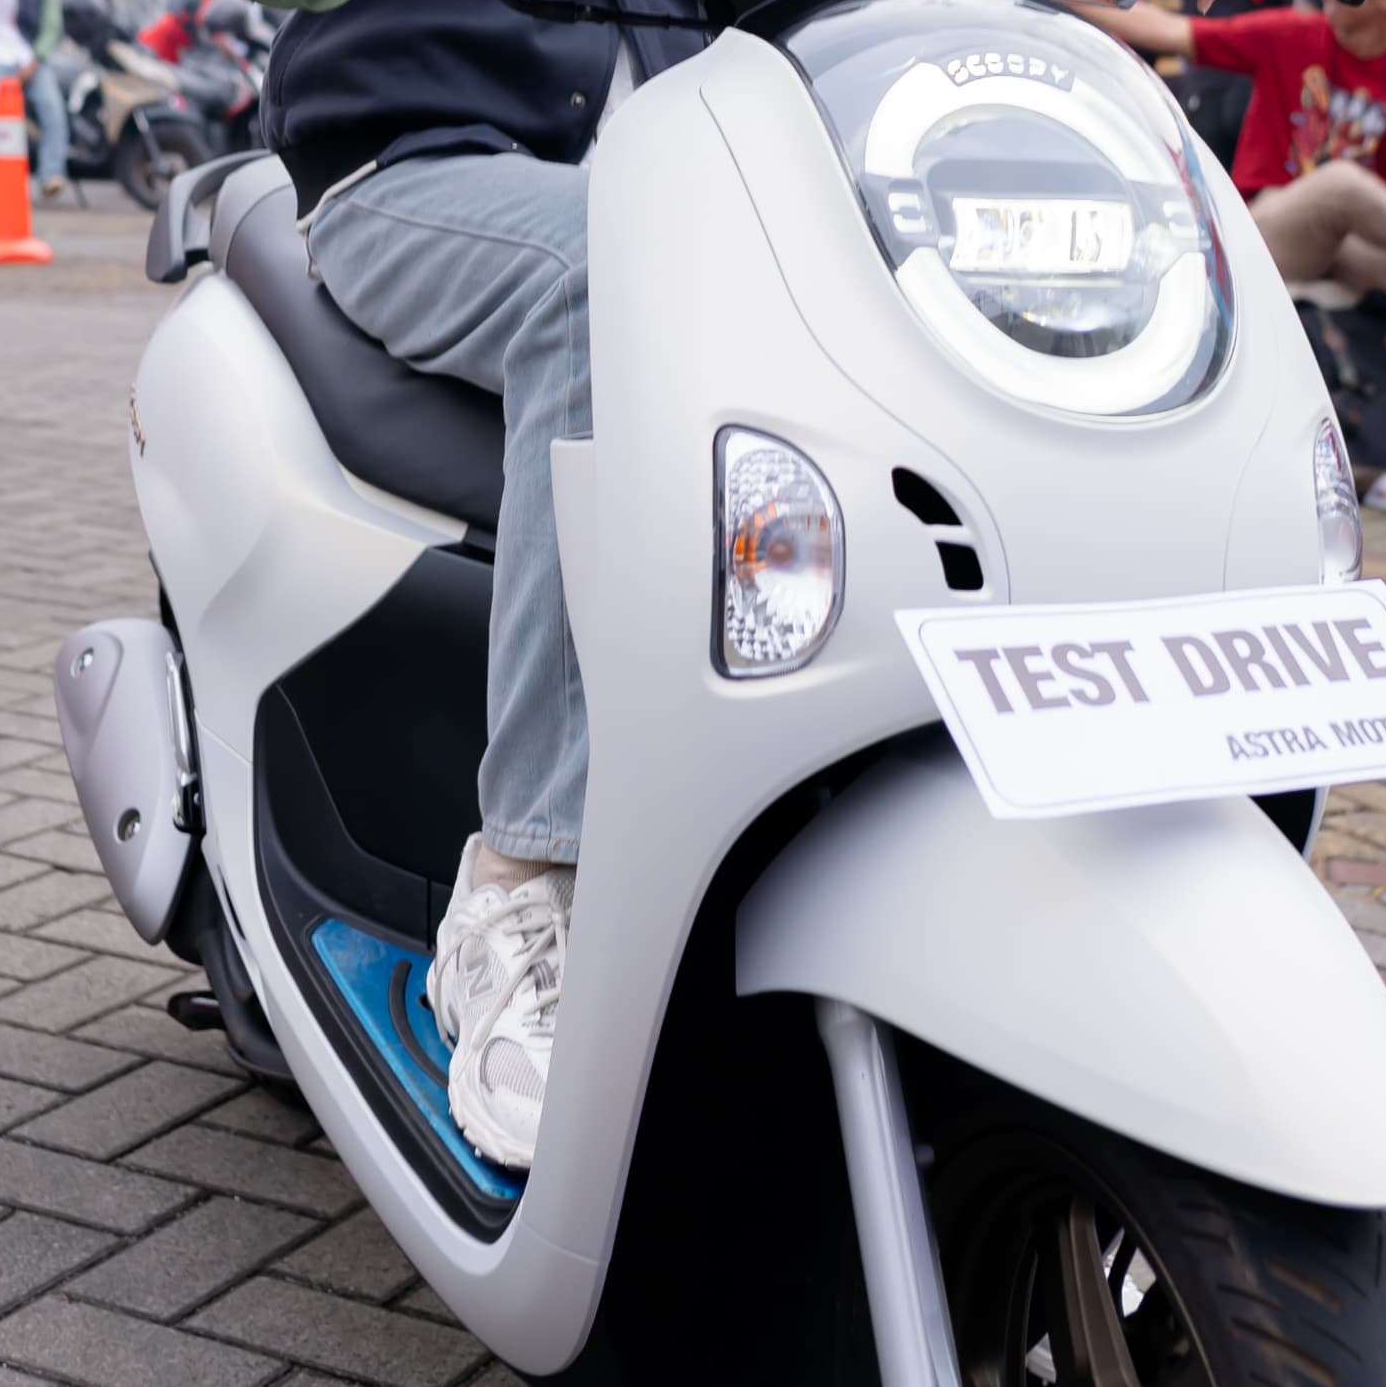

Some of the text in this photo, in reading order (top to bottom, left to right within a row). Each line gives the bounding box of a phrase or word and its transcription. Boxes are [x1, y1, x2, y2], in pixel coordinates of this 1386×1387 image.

[947, 52, 1069, 85] SCOOPY
[953, 638, 1150, 714] TEST
[1225, 728, 1328, 761] ASTRA
